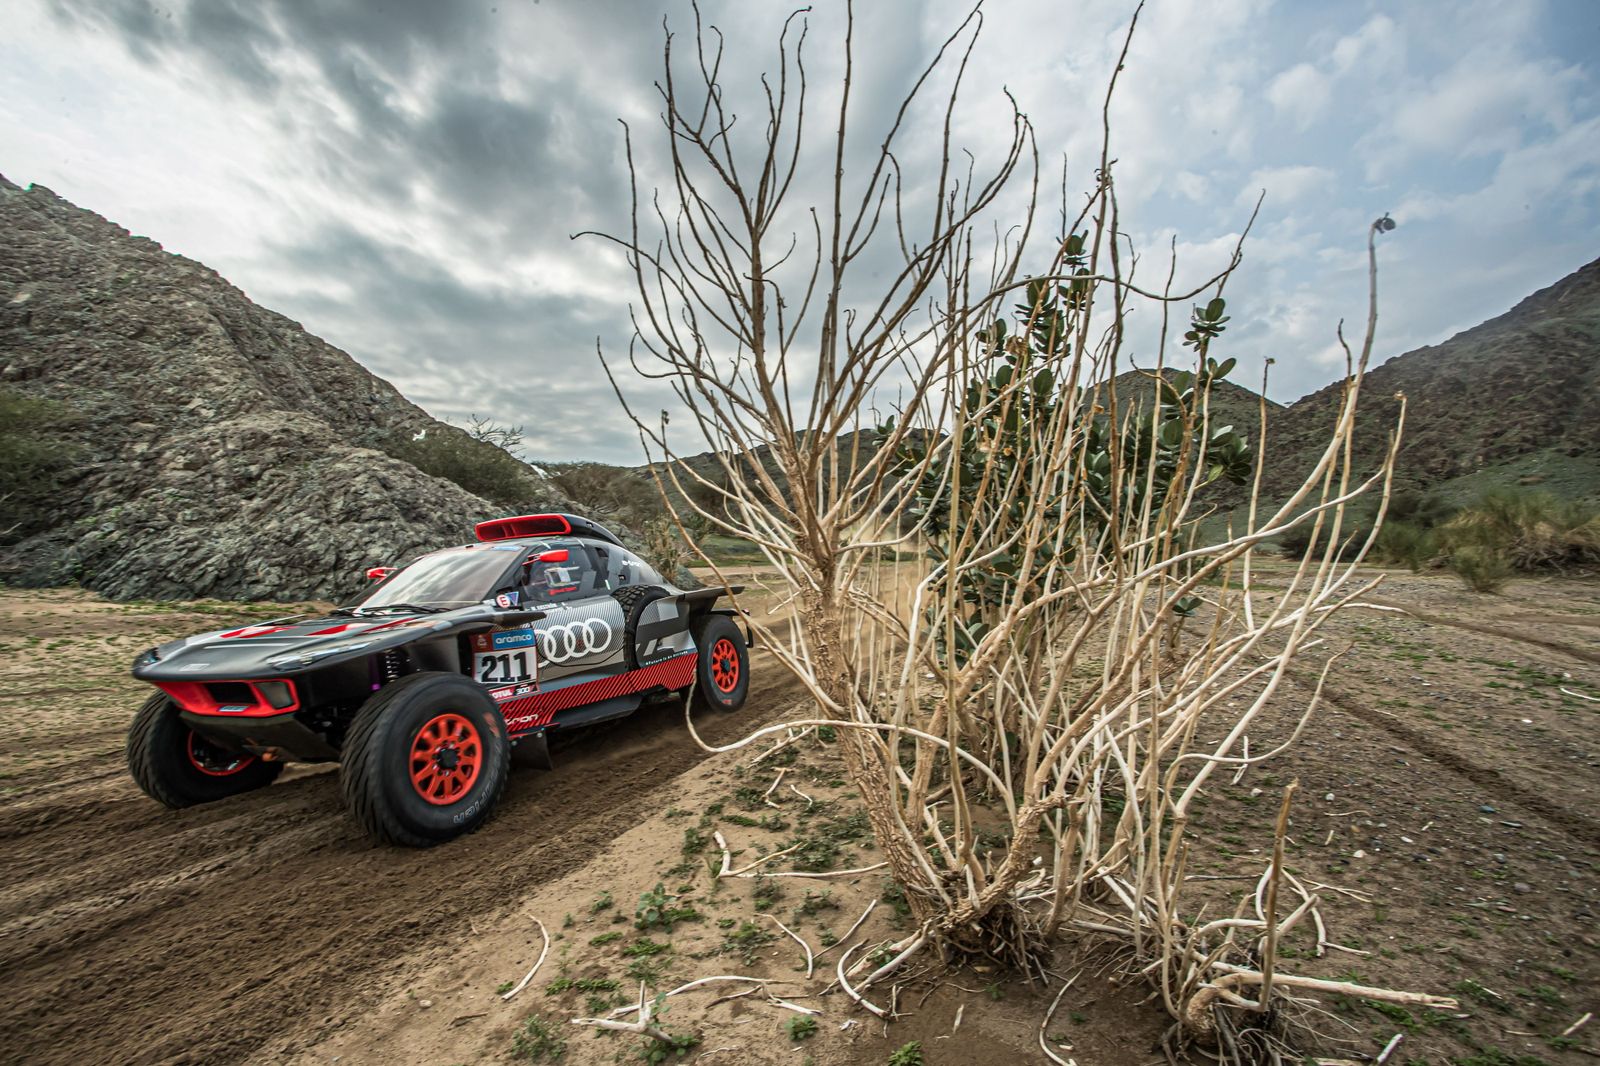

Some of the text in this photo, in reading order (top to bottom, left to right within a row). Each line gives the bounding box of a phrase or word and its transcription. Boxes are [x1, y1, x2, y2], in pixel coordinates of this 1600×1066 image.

[495, 633, 533, 645] aramco
[481, 651, 531, 683] 211
[490, 688, 513, 700] OTUL
